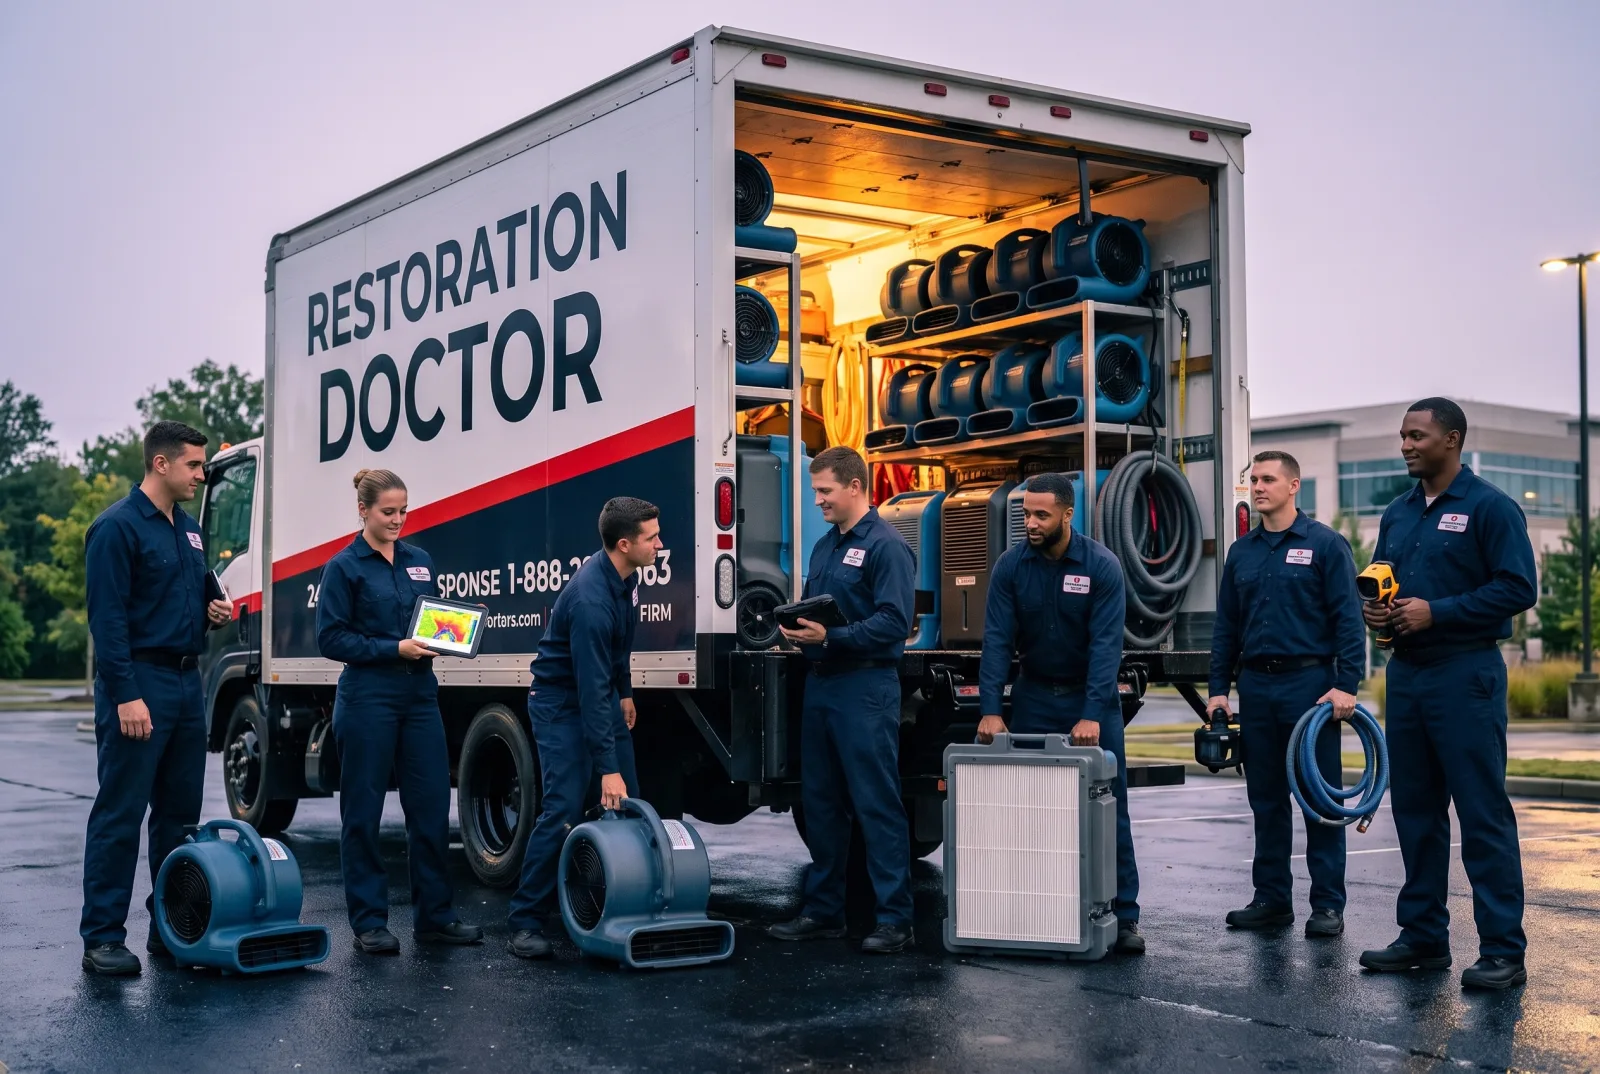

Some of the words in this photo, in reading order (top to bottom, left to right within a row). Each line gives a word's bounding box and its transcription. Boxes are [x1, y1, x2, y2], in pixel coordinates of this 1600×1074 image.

[308, 170, 627, 356] RESTORATION
[319, 291, 603, 463] DOCTOR
[437, 569, 501, 599] SPONSE
[507, 555, 592, 595] 1-888-
[640, 603, 672, 622] FIRM
